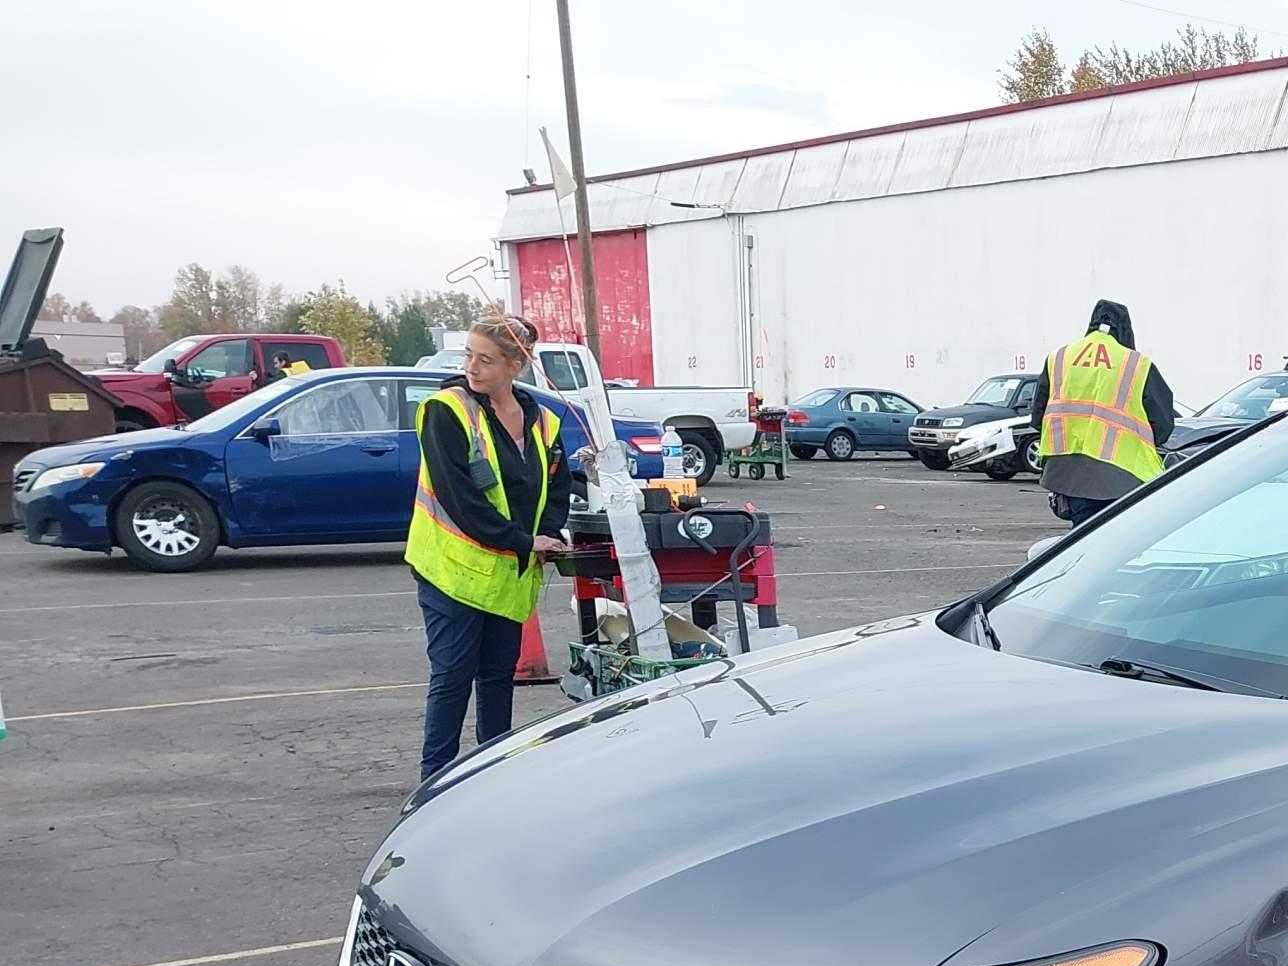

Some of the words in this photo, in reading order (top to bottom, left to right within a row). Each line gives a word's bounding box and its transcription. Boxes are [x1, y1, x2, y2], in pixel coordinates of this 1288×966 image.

[824, 355, 836, 369] 20
[905, 354, 915, 369] 19
[1015, 355, 1026, 370] 18
[1248, 354, 1263, 371] 16
